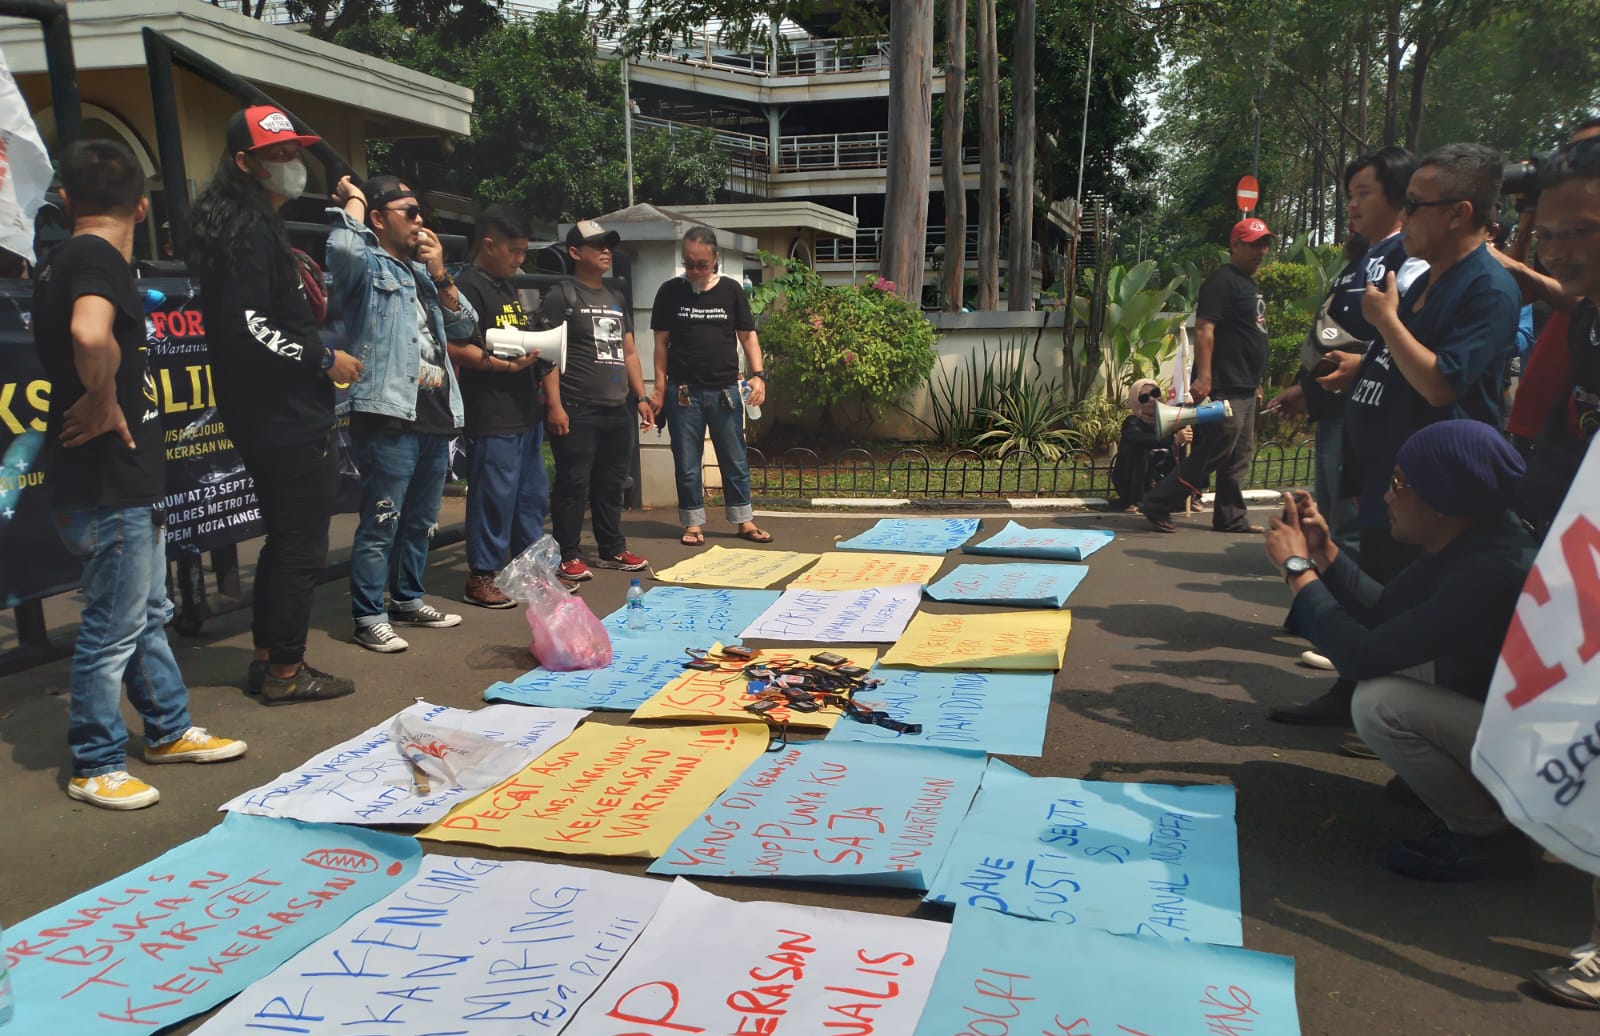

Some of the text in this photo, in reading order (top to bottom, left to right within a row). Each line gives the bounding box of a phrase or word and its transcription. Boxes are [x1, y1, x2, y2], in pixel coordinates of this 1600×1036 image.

[150, 310, 206, 338] FOR
[168, 492, 259, 525] OLRES METRO TA
[197, 516, 226, 535] KOTA
[226, 507, 263, 527] TANGE
[203, 484, 217, 500] 23
[219, 478, 247, 495] SEPT
[441, 750, 580, 833] PECAT ASN
[544, 748, 672, 844] KEKERASAN
[667, 813, 741, 867] YANG
[812, 804, 886, 866] SAJA
[44, 869, 230, 967] BUKAN
[97, 875, 357, 1027] KEKERASAN
[245, 858, 506, 1034] IR KENCING
[340, 952, 476, 1027] KAN
